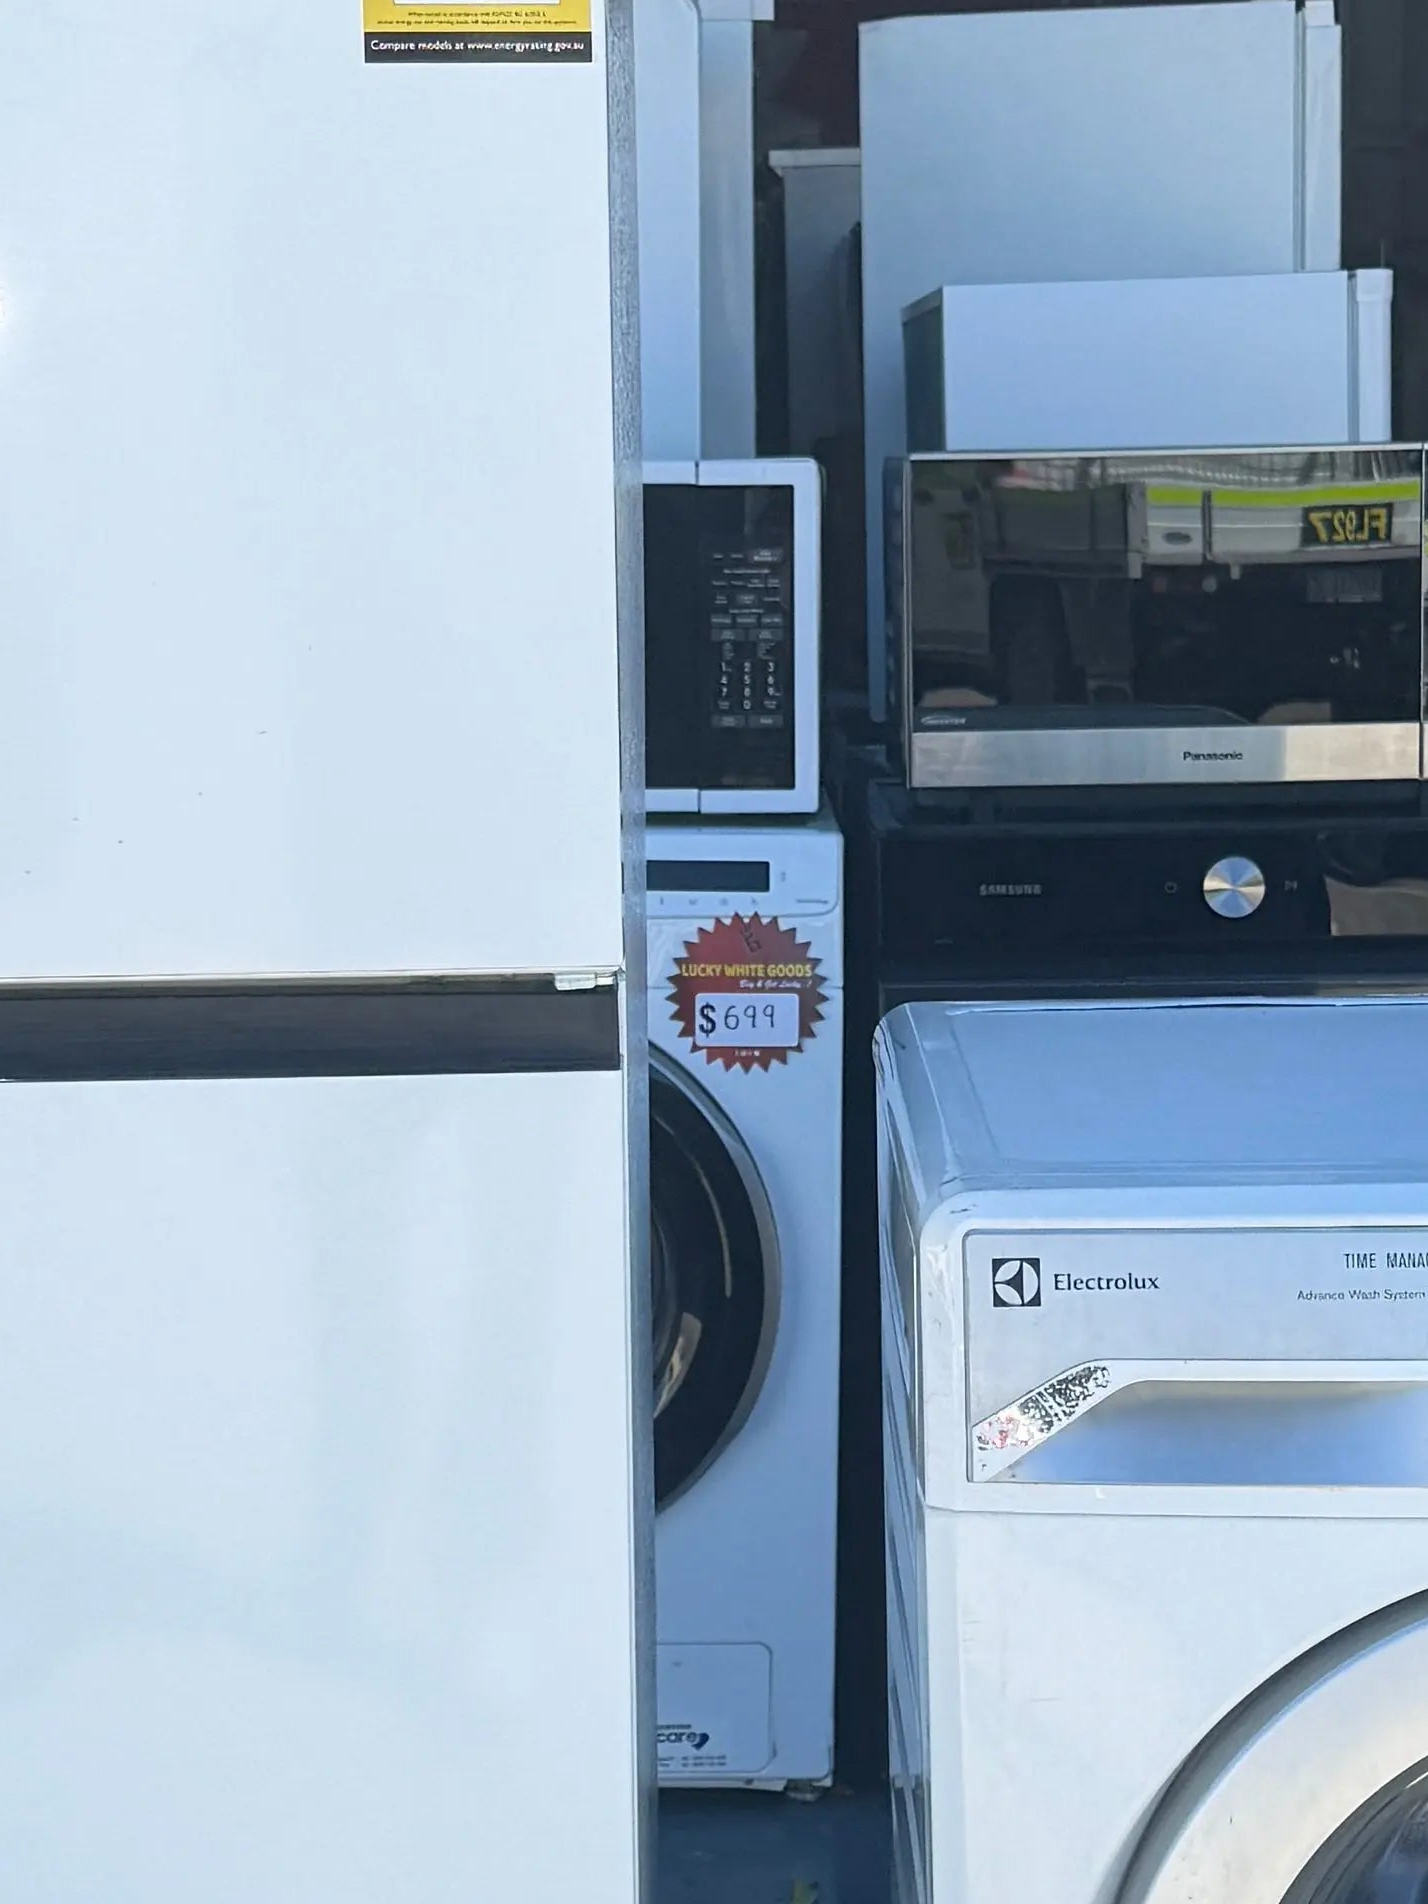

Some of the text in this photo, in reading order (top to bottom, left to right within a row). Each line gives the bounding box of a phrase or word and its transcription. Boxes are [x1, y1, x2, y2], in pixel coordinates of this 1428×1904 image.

[371, 40, 416, 53] Compare
[418, 40, 453, 51] models
[455, 40, 465, 51] at
[1183, 750, 1243, 761] Panasonic
[980, 884, 1042, 896] SAMSUNG
[682, 963, 813, 978] LUCKY WHITE GOODS
[1343, 1253, 1377, 1269] TIME
[1053, 1273, 1160, 1291] Electrolux
[1348, 1288, 1380, 1300] Wash
